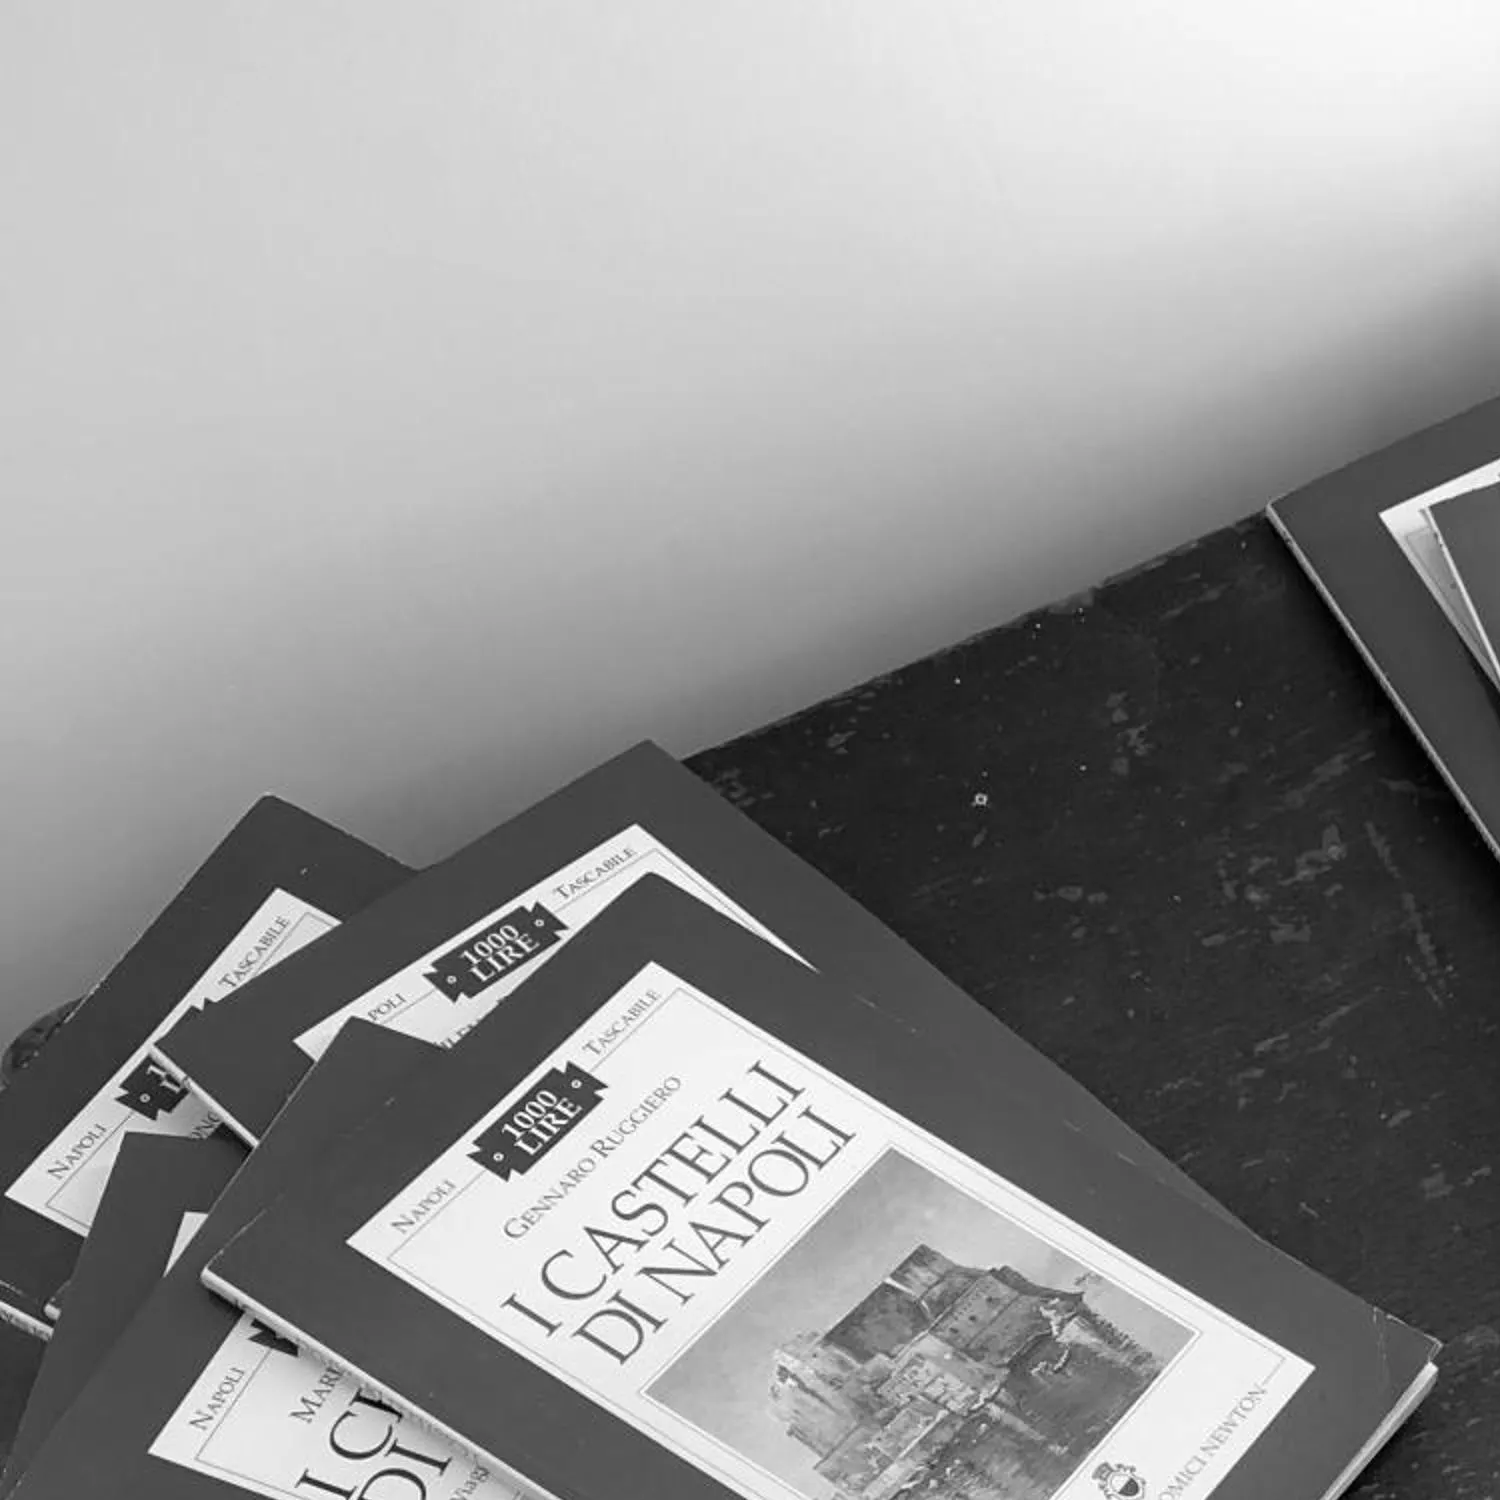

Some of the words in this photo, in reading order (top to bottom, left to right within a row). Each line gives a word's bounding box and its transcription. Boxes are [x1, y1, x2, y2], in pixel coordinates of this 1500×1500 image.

[459, 924, 520, 966] 1000
[469, 933, 541, 983] LIRE
[501, 1089, 558, 1140] 1000
[513, 1097, 582, 1156] LIRE
[500, 1293, 563, 1337] I
[541, 1060, 806, 1300] CASTELLI
[571, 1290, 668, 1365] DI
[635, 1105, 857, 1307] NAPOLI
[1200, 1382, 1269, 1457] NEWTON
